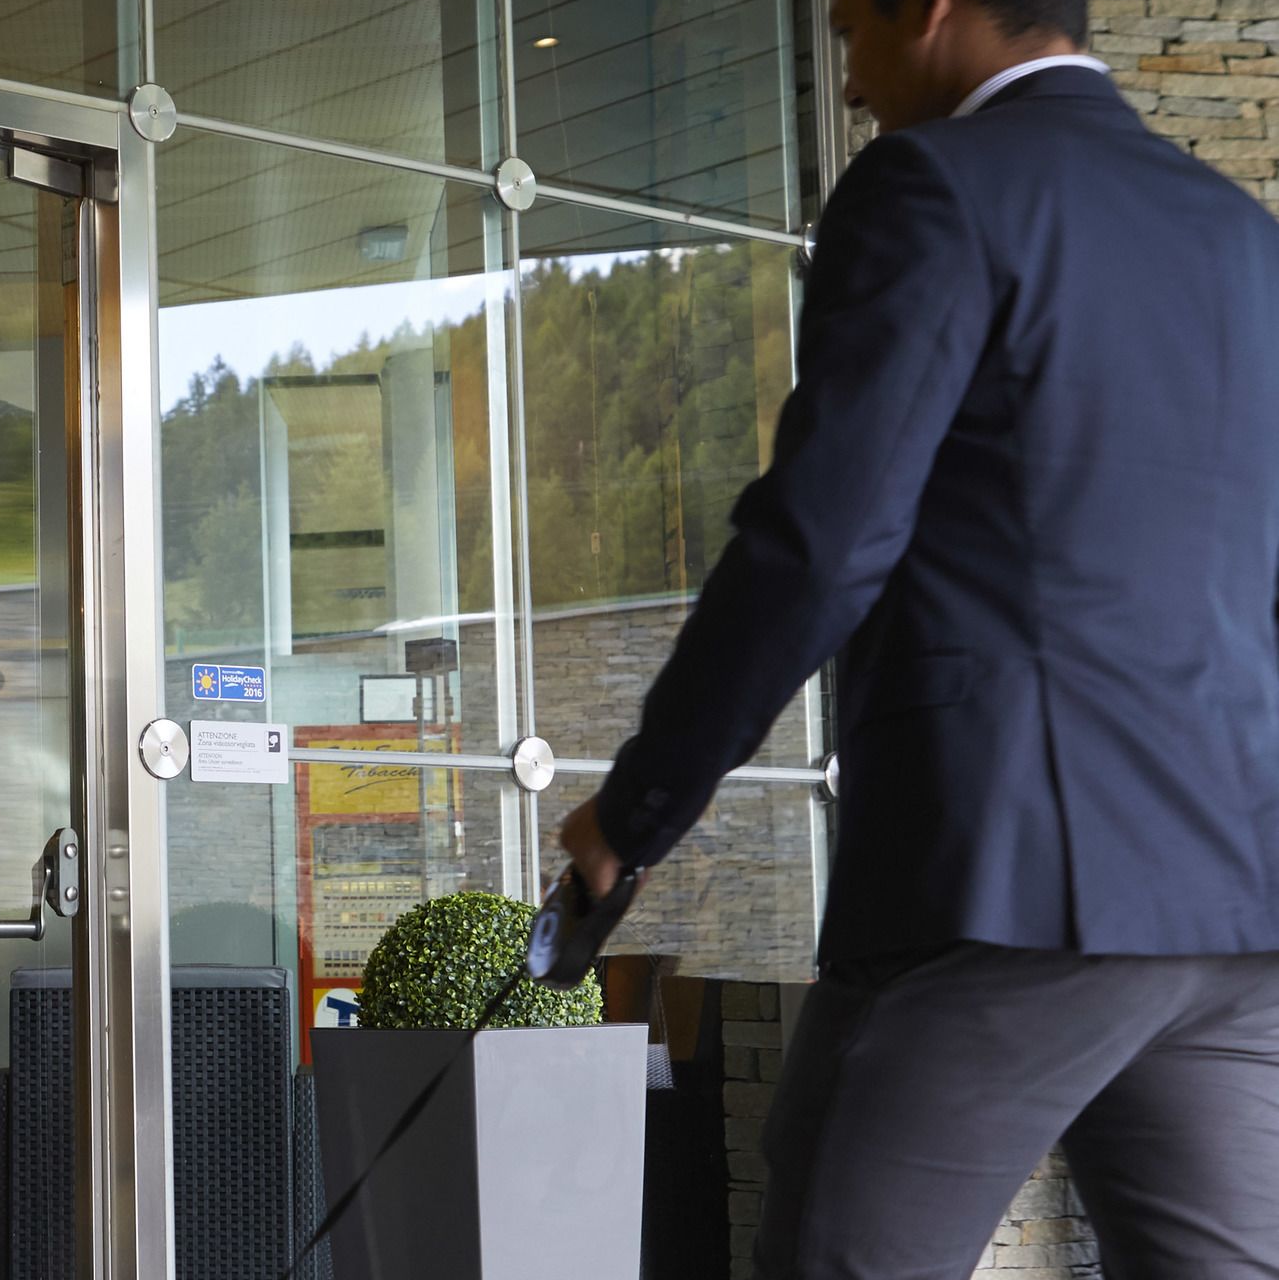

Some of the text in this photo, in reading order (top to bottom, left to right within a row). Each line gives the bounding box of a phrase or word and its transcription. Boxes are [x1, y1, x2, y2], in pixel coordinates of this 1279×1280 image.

[222, 675, 262, 685] HolidayCheck
[244, 687, 263, 697] 2016
[198, 732, 237, 740] ATTENZIONE
[340, 765, 418, 778] Tabacch
